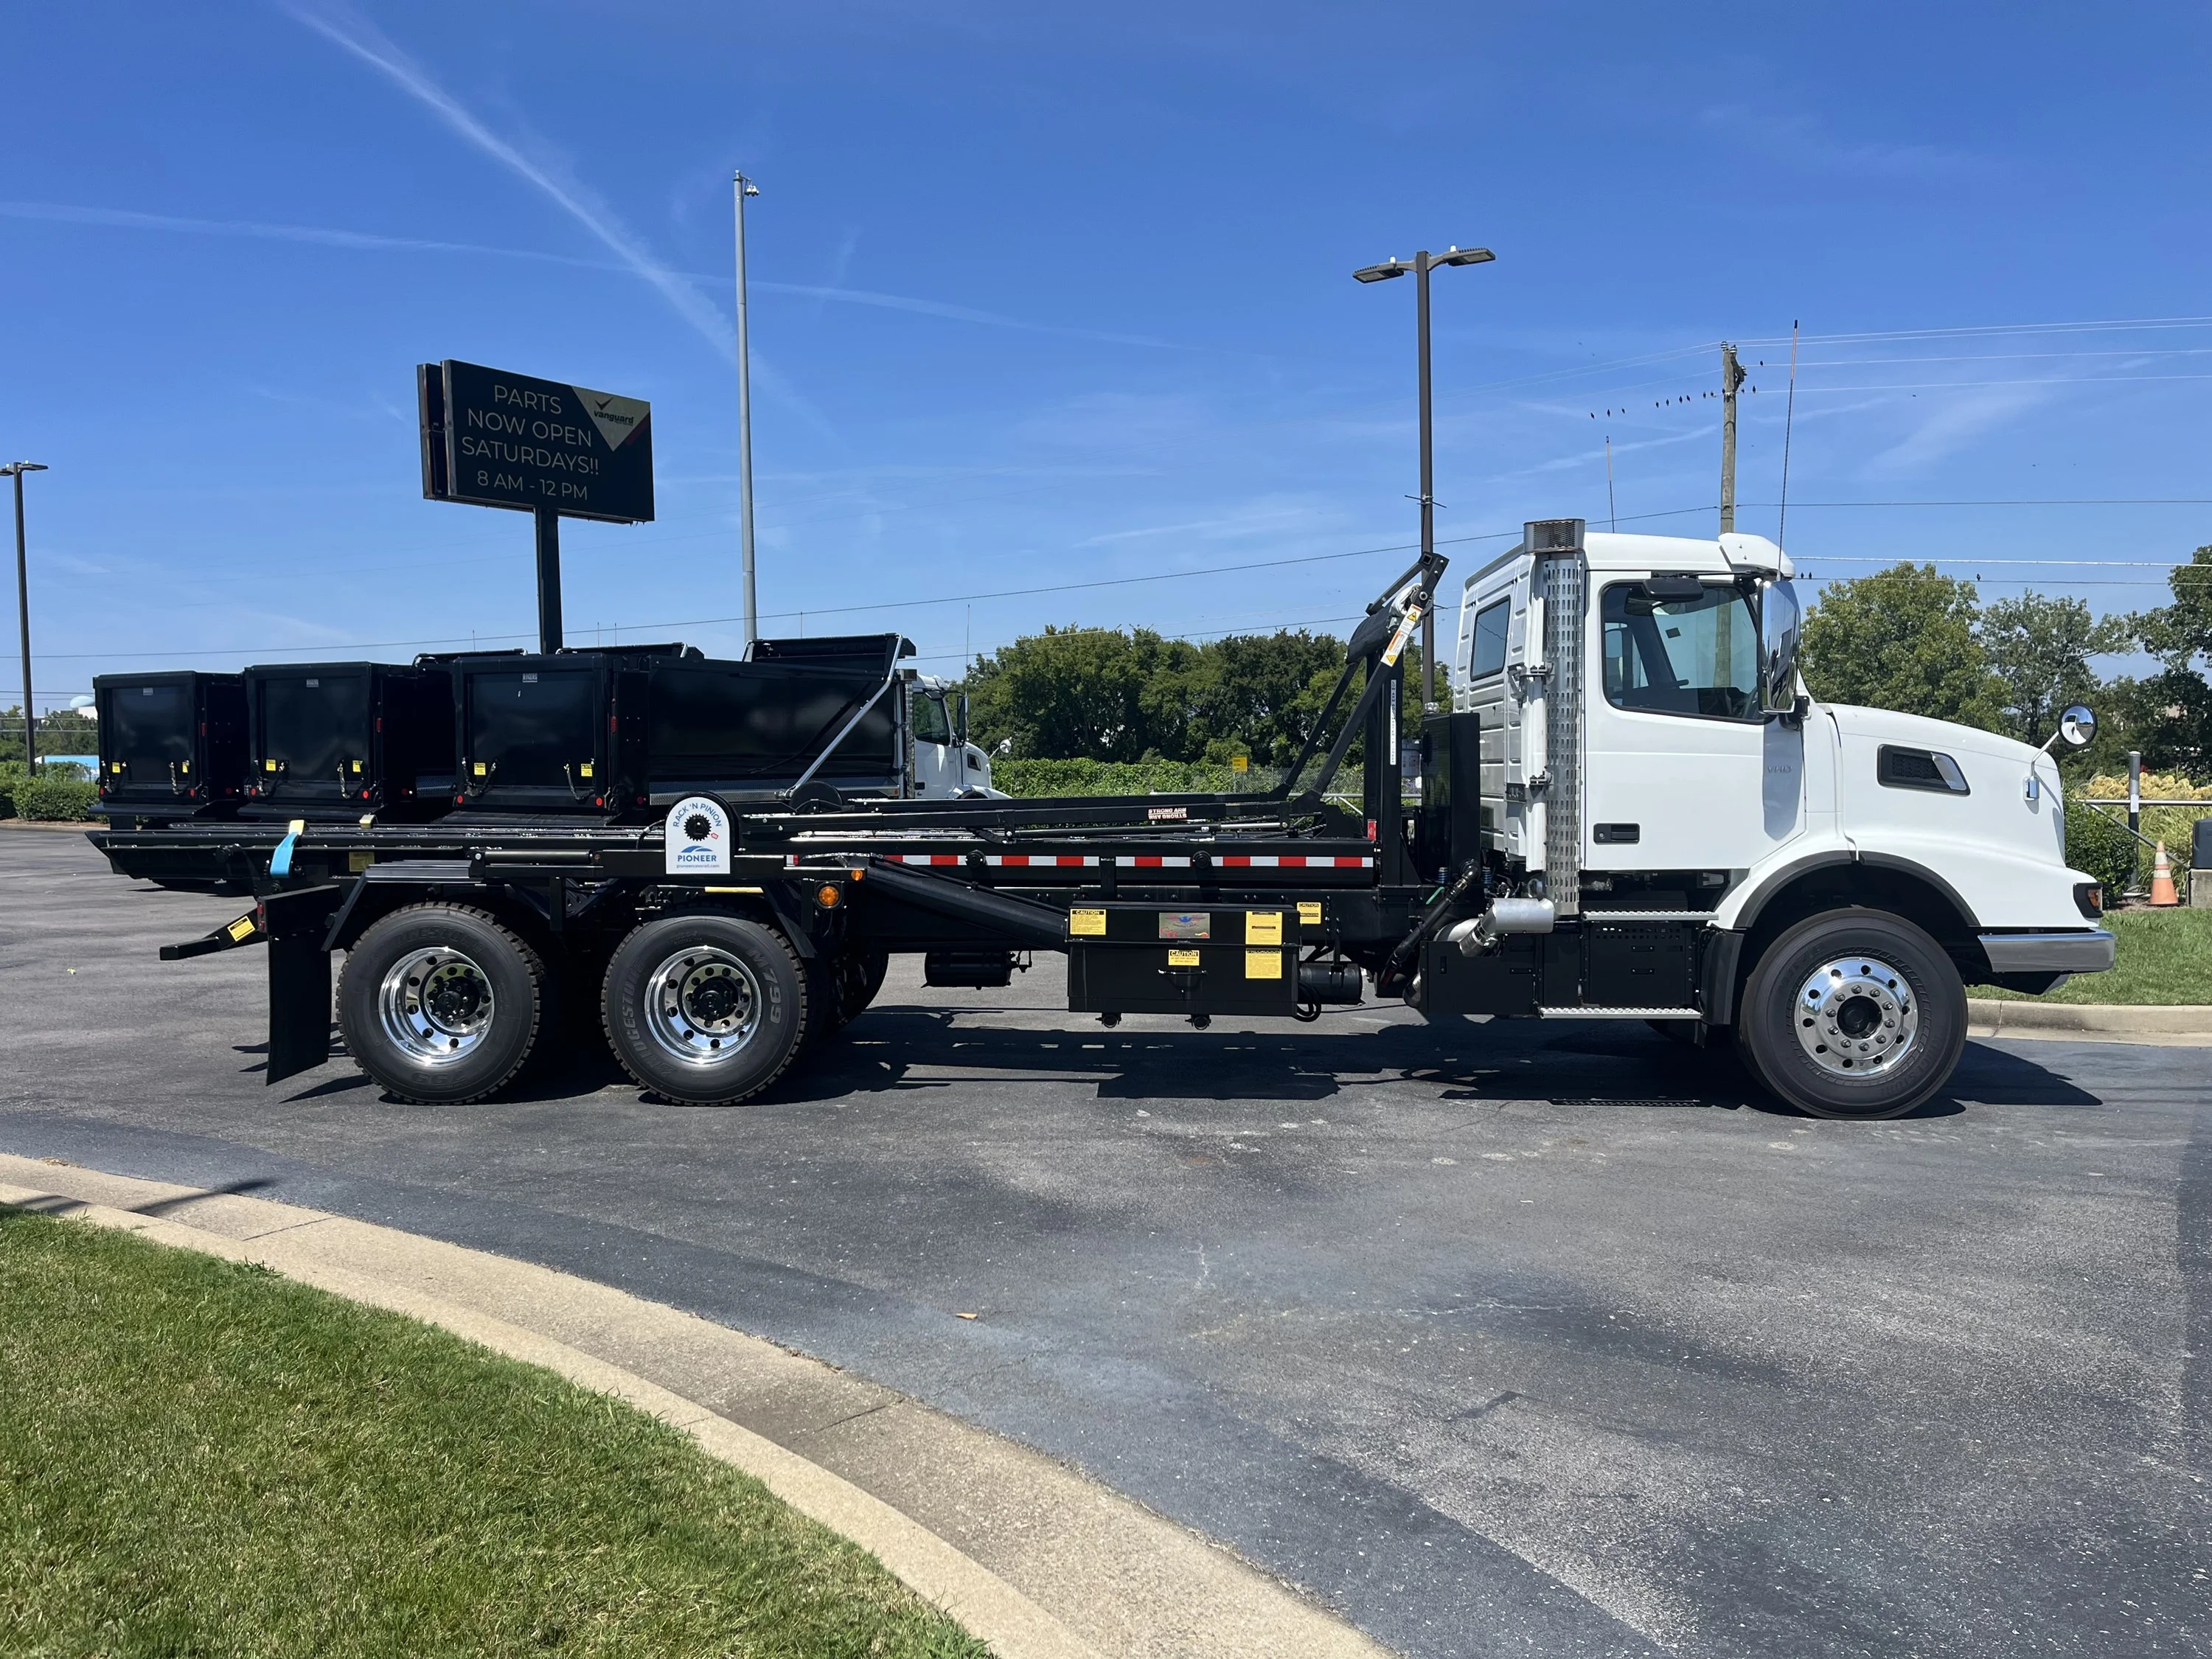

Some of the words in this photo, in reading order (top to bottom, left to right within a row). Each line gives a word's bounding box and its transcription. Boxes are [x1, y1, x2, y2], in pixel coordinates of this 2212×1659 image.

[494, 384, 562, 414] PARTS
[467, 408, 526, 436] NOW
[532, 420, 591, 448] OPEN
[594, 410, 634, 424] vanguard
[462, 437, 599, 476] SATURDAYS!!
[477, 470, 489, 487] 8
[494, 473, 524, 492] AM
[540, 479, 557, 496] 12
[561, 482, 588, 501] PM
[672, 806, 689, 827] RACK
[700, 803, 723, 827] PINION
[746, 947, 782, 1024] M799
